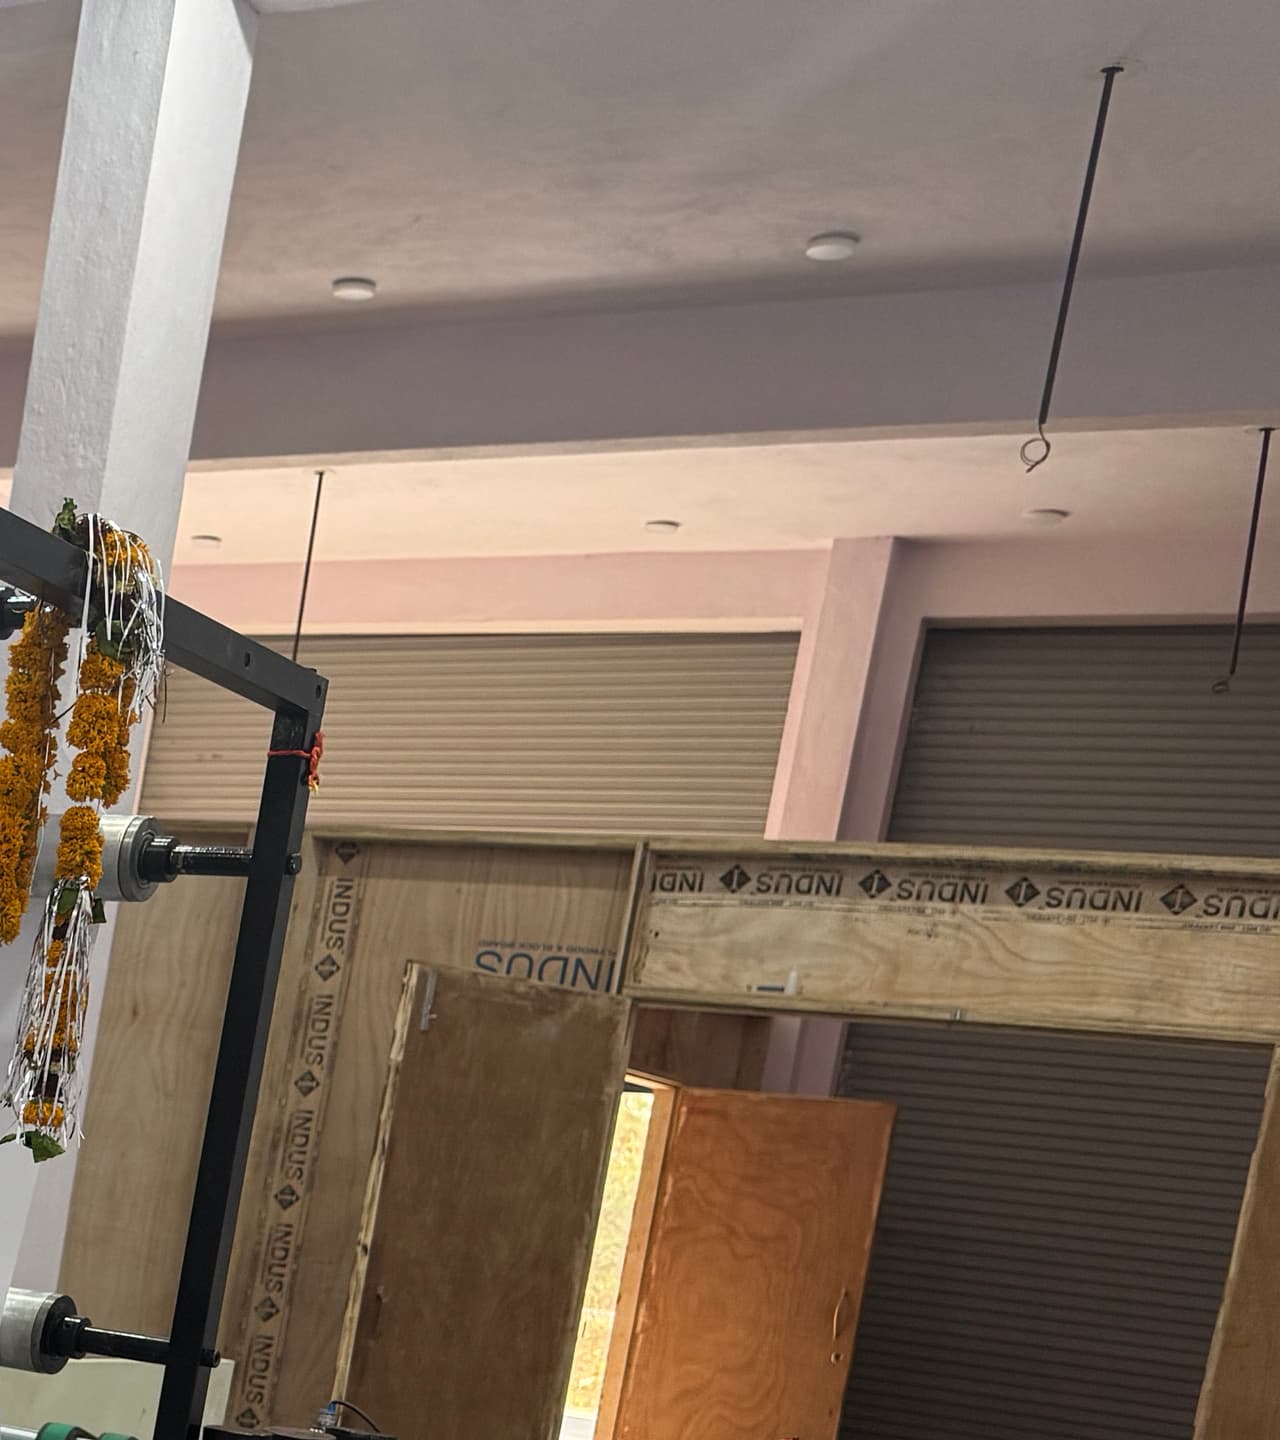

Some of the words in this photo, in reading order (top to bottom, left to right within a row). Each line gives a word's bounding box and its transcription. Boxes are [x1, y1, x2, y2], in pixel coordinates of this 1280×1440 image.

[326, 877, 354, 951] INDUS
[756, 872, 844, 897] INDUS
[896, 878, 989, 905] INDUS
[1045, 887, 1143, 913] INDUS
[305, 993, 334, 1067] INDUS
[285, 1109, 314, 1181] INDUS
[265, 1222, 293, 1293] INDUS
[246, 1333, 274, 1406] INDUS
